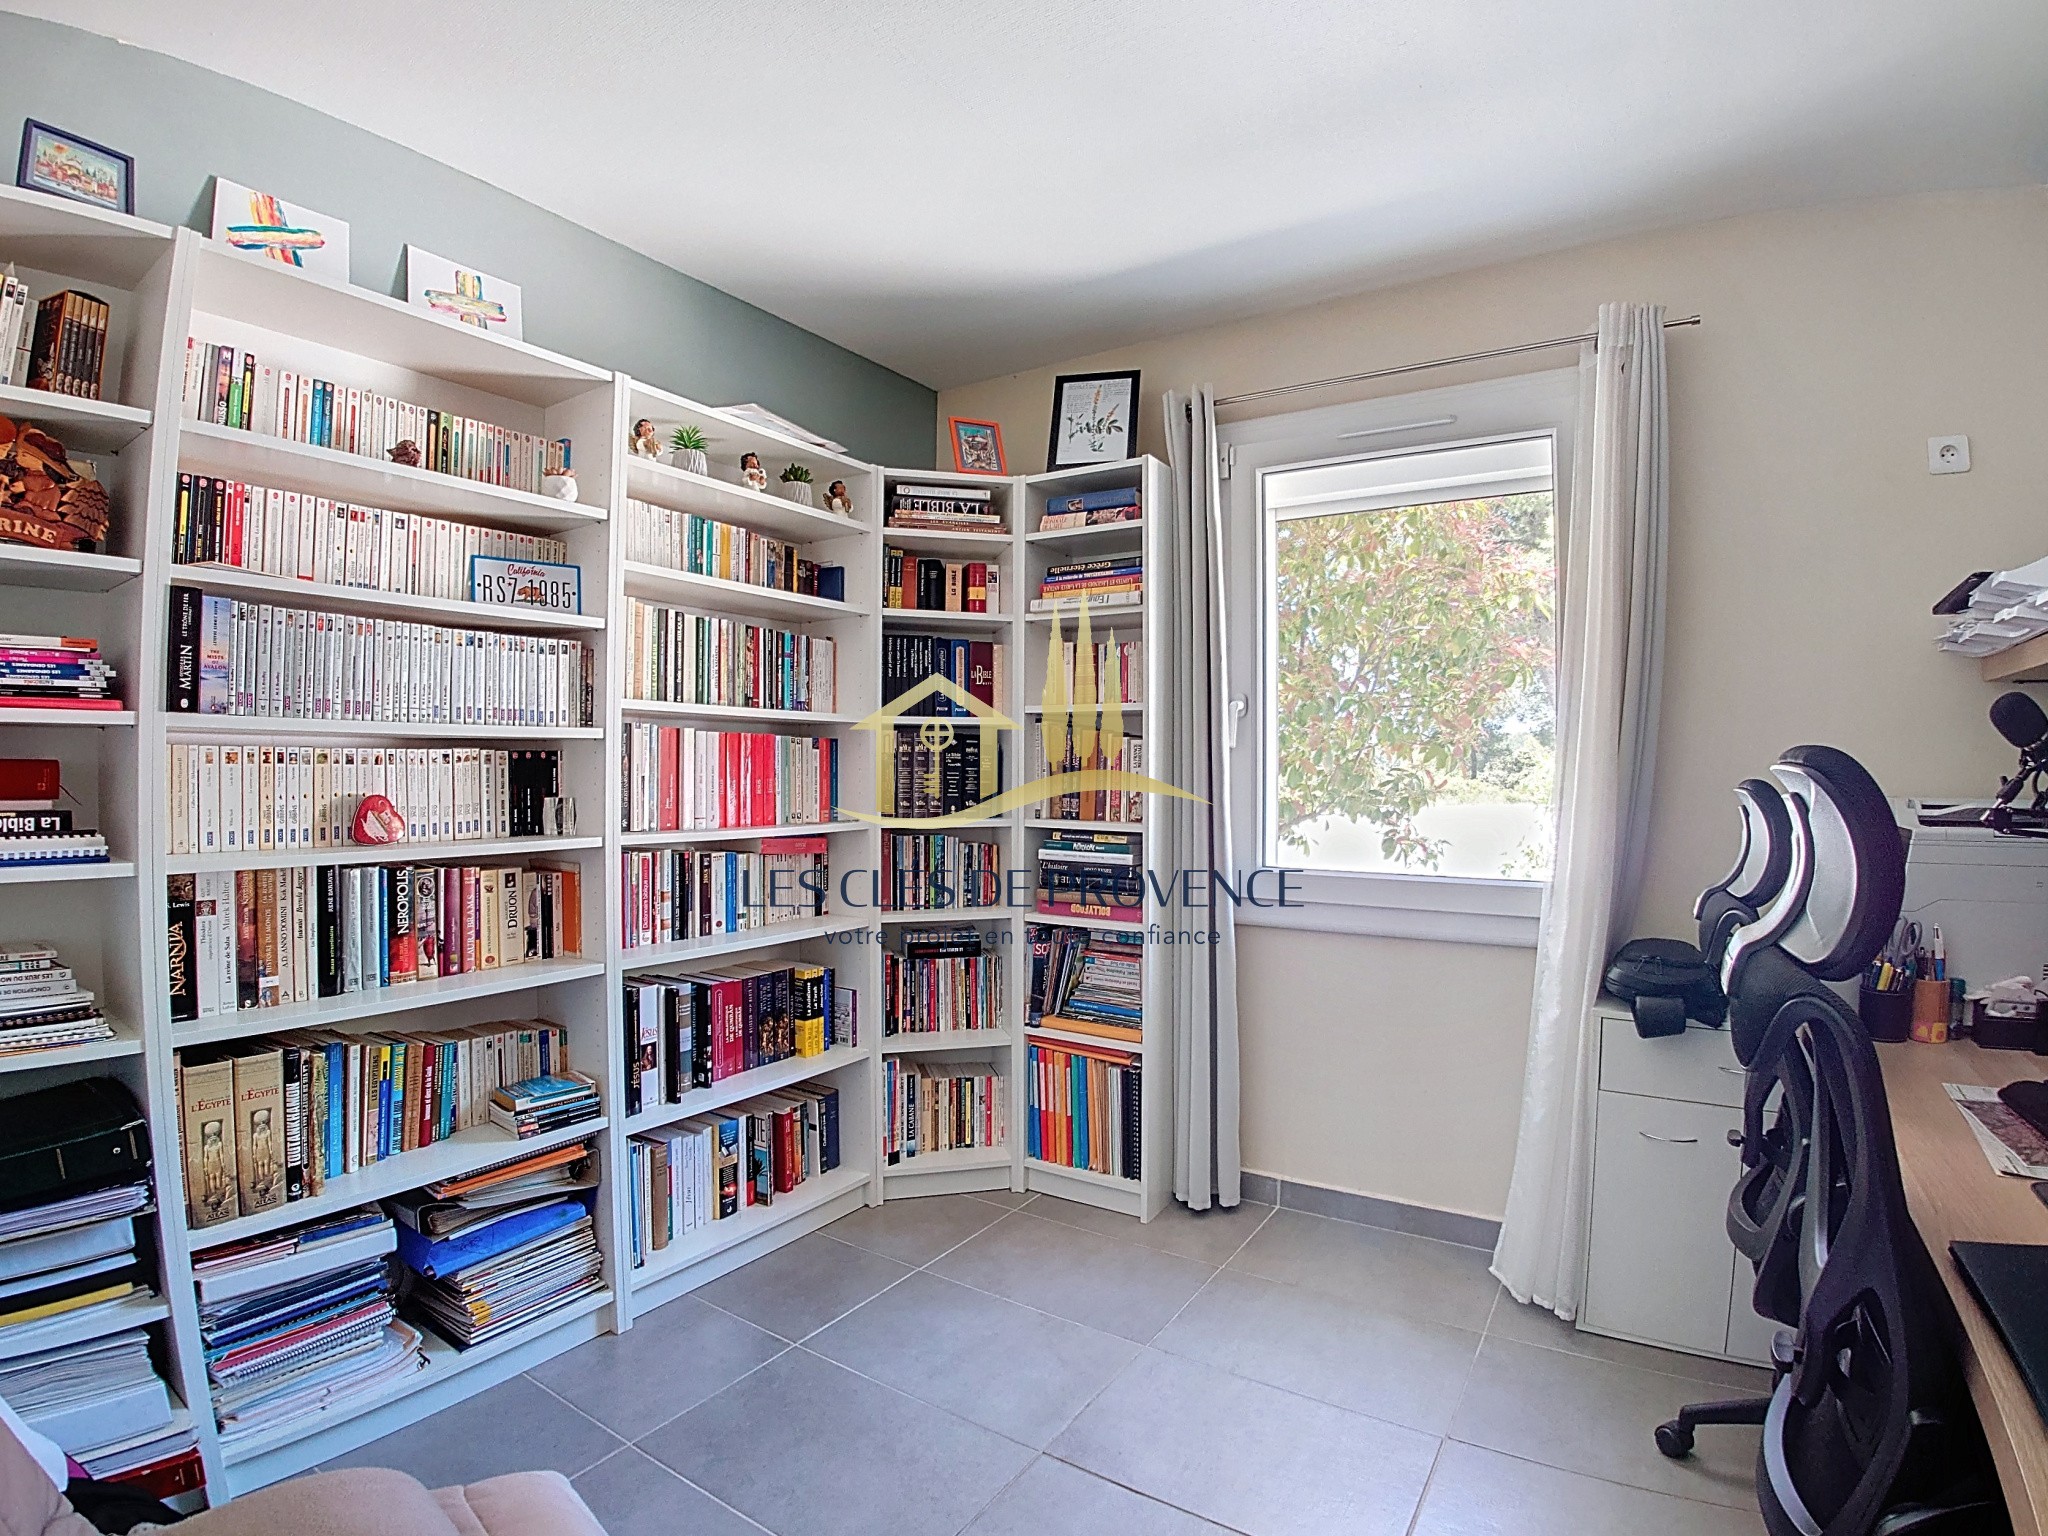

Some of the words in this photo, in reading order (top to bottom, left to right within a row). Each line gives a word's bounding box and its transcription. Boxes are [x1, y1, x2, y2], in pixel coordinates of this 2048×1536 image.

[914, 500, 954, 513] BIBLE
[959, 503, 980, 514] LA
[507, 564, 546, 577] California
[1050, 564, 1085, 574] éternelle
[528, 579, 571, 609] 1985
[179, 644, 192, 689] MARTIN
[40, 817, 60, 831] La
[222, 880, 231, 905] Halter
[397, 870, 409, 934] NEROPOLIS
[222, 906, 231, 931] Marek
[466, 895, 474, 927] BRAMS
[508, 890, 517, 928] DRUON
[1071, 904, 1110, 916] BOLLYFOOD
[168, 921, 186, 996] NARNIA
[467, 930, 475, 961] LAURA
[631, 1062, 640, 1089] JÉSUS
[286, 1082, 301, 1167] TOUTANKHAMON
